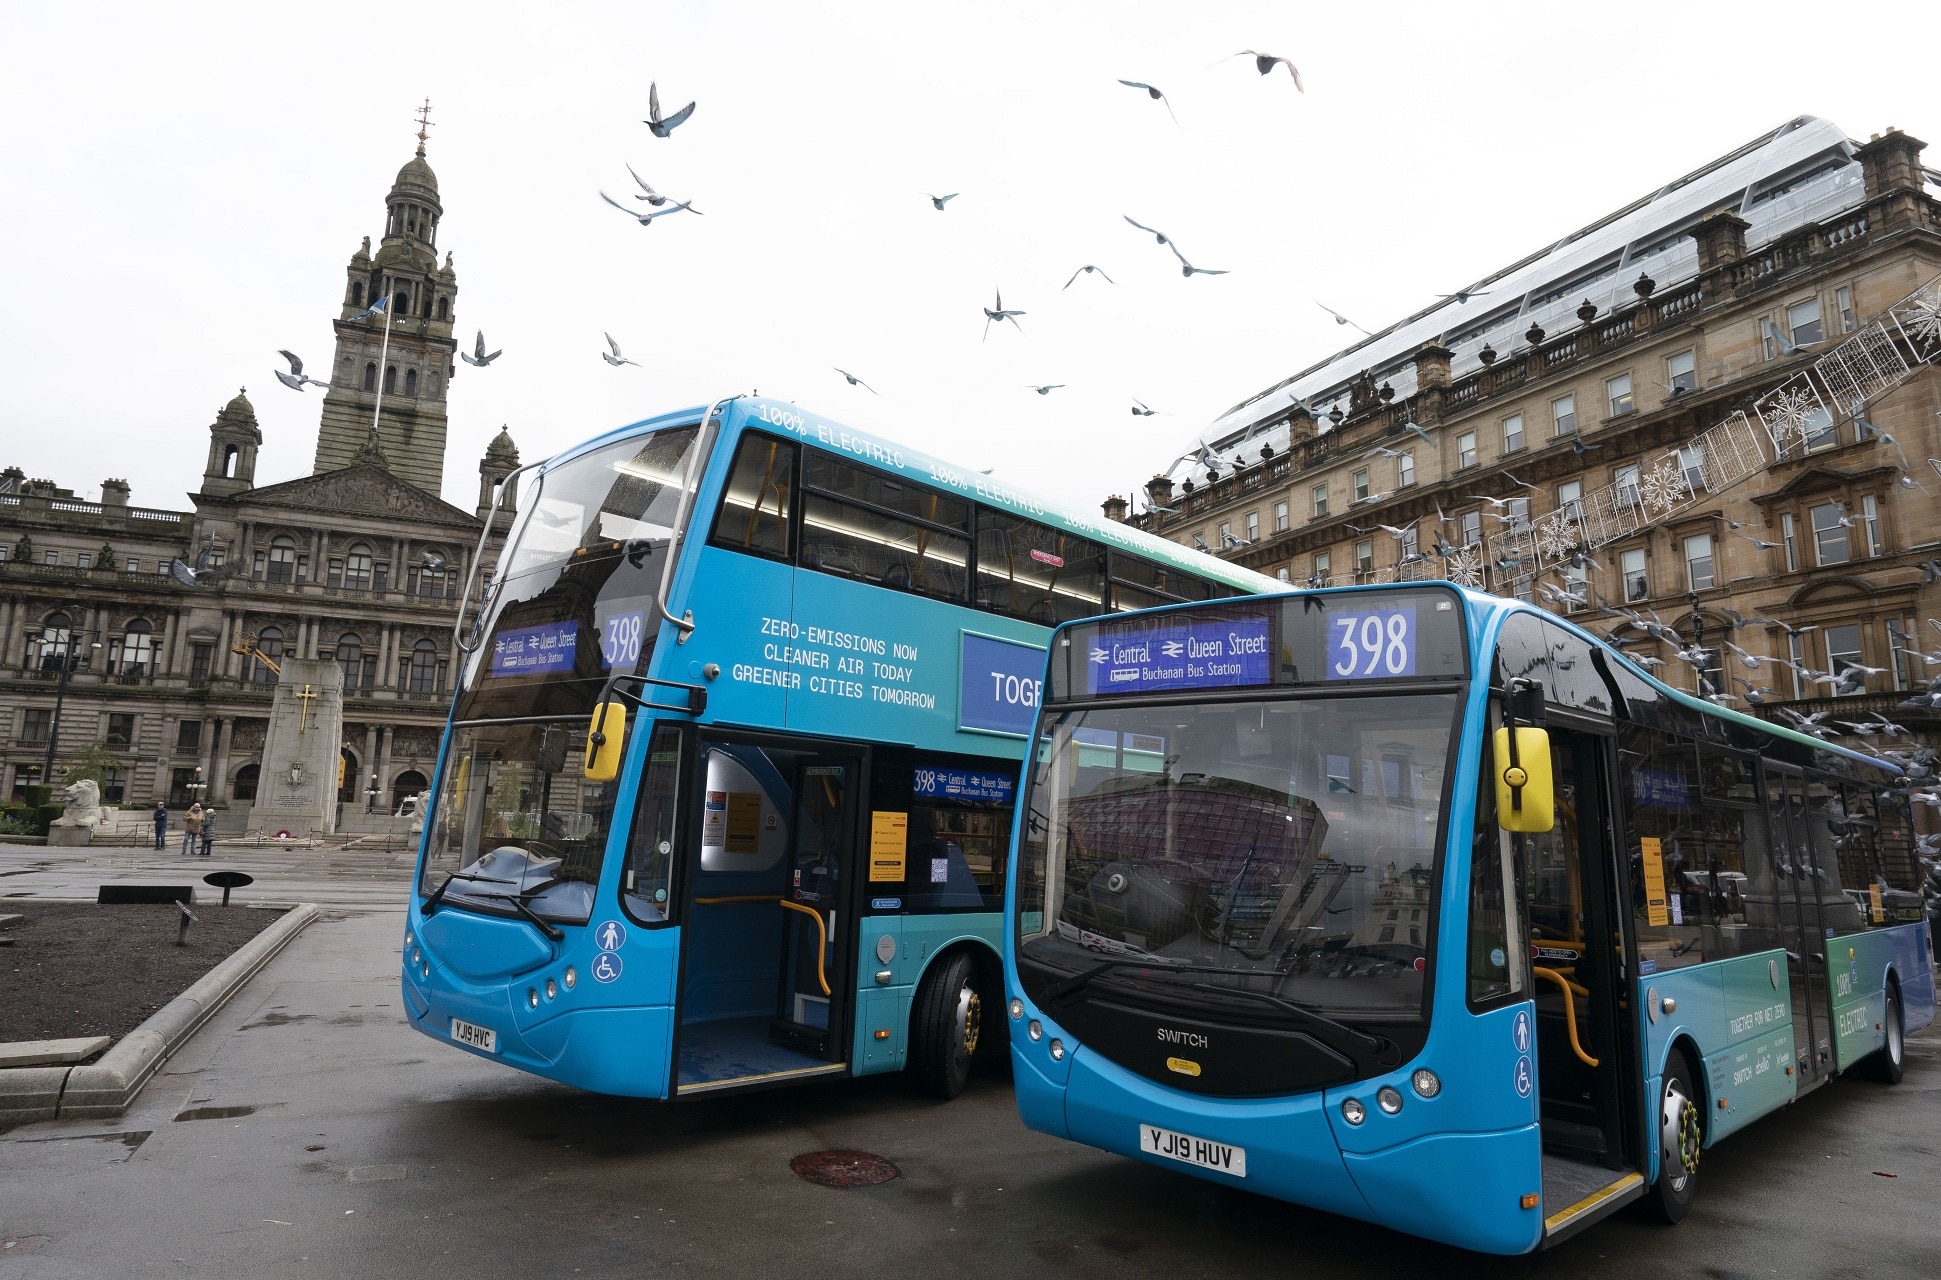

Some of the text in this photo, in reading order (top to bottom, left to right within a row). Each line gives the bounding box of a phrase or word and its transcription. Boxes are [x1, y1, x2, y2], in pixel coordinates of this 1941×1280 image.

[759, 403, 905, 469] 100% ELECTRIC
[929, 464, 1044, 516] 100% ELECTRIC
[1063, 510, 1155, 554] 100% ELECTRIC
[506, 630, 577, 654] Central Queen Street
[606, 615, 641, 664] 398
[761, 617, 918, 661] ZERO-EMISSIONS NOW
[1112, 632, 1266, 665] Central Queen Street
[1334, 613, 1408, 676] 398
[517, 652, 563, 667] Buchanan Bus Station
[764, 643, 913, 683] CLEANER AIR TODAY
[1142, 662, 1241, 681] Buchanan Bus Station
[732, 663, 935, 709] GREENER CITIES TOMORROW
[913, 769, 936, 792] 398
[948, 773, 1012, 790] Central Queen Street
[961, 787, 1004, 798] Buchanan Bus Station
[1836, 972, 1852, 997] 100%
[456, 1021, 490, 1047] YJ19 HVC
[1730, 1003, 1786, 1035] TOGETHER FOR NET ZERO
[1840, 1006, 1867, 1037] ELECTRIC
[1157, 1028, 1208, 1049] SWITCH
[1733, 1065, 1753, 1086] SWITCH
[1756, 1056, 1770, 1075] abellio
[1151, 1129, 1232, 1169] YJ19 HUV
